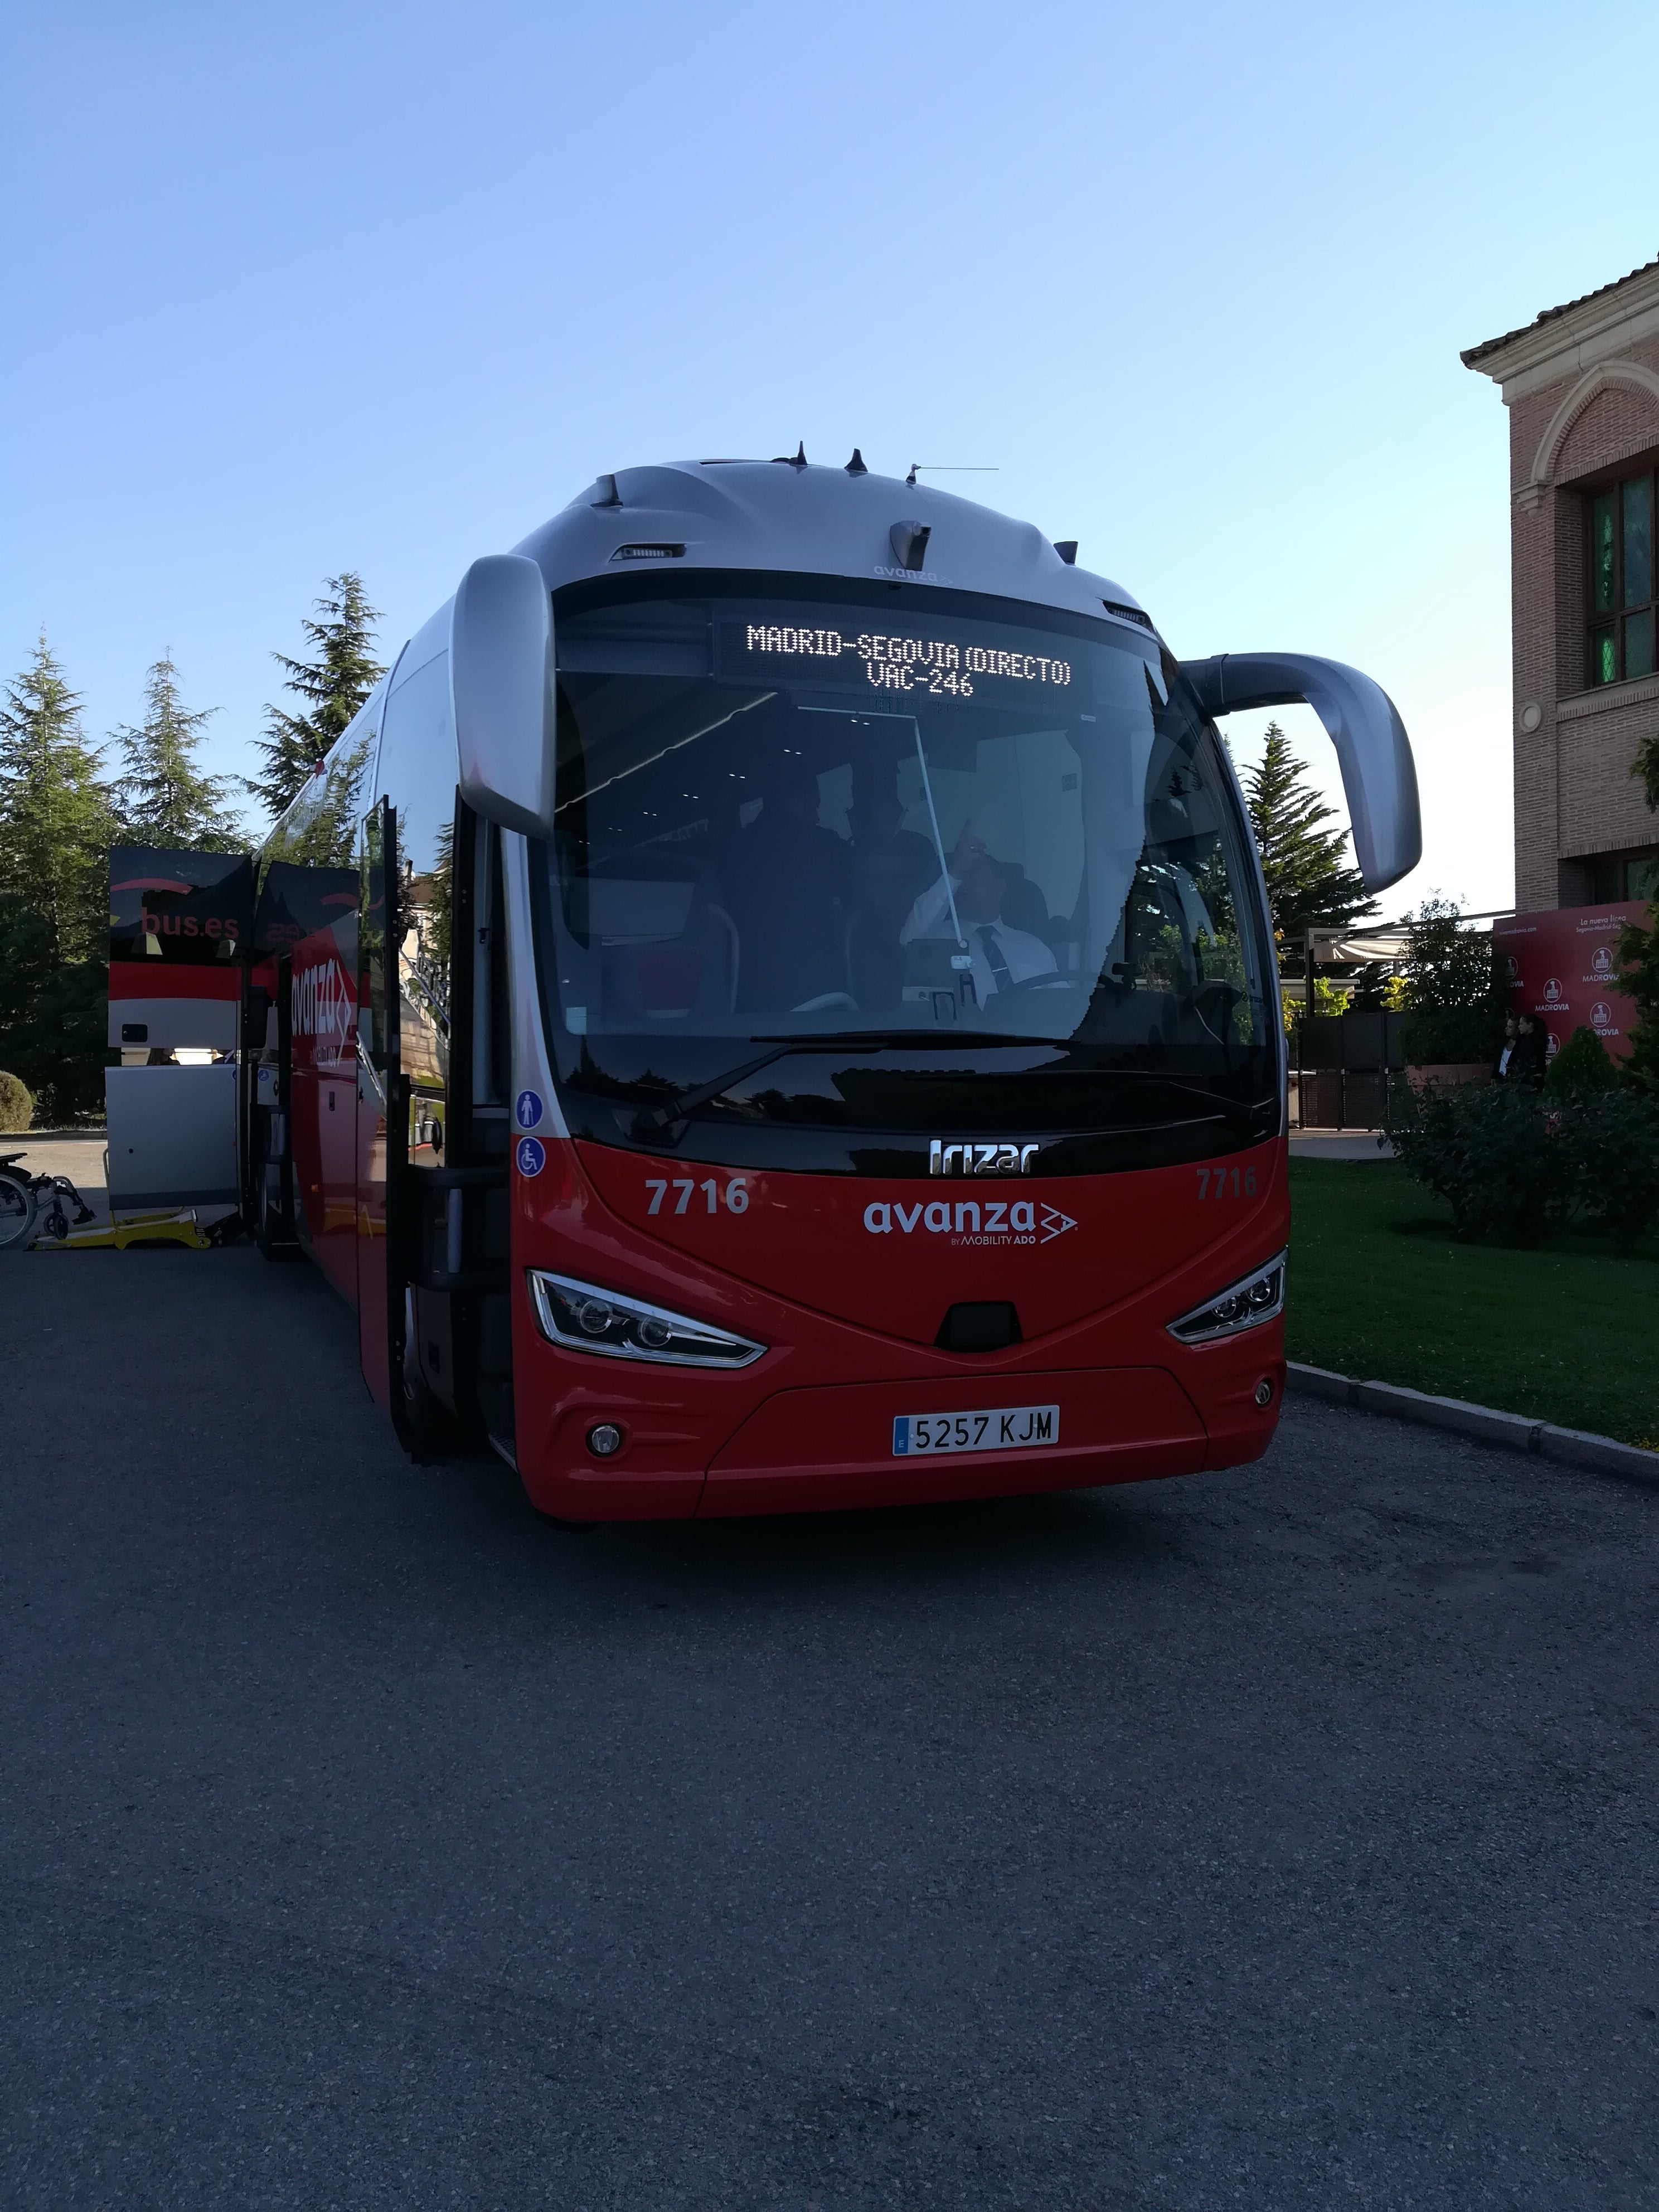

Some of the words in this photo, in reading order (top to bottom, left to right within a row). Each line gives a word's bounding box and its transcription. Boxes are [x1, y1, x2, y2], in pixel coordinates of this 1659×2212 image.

[874, 565, 938, 582] avanza
[746, 625, 959, 669] MADRID-SEGOVIA
[965, 647, 1071, 685] (DIRECTO)
[867, 662, 974, 697] VAC-246
[141, 906, 239, 940] bus.es
[292, 958, 336, 1037] avanza
[1535, 1003, 1570, 1012] MADROVIA
[1593, 1028, 1619, 1036] DROVIA
[929, 1139, 1039, 1175] Irizar
[645, 1178, 749, 1215] 7716
[1196, 1165, 1257, 1200] 7716
[864, 1201, 1037, 1234] avanza
[961, 1235, 1012, 1245] MOBILITY
[1013, 1235, 1036, 1245] ADO
[898, 1439, 905, 1448] E
[915, 1417, 989, 1449] 5257
[1000, 1411, 1051, 1443] KJM
